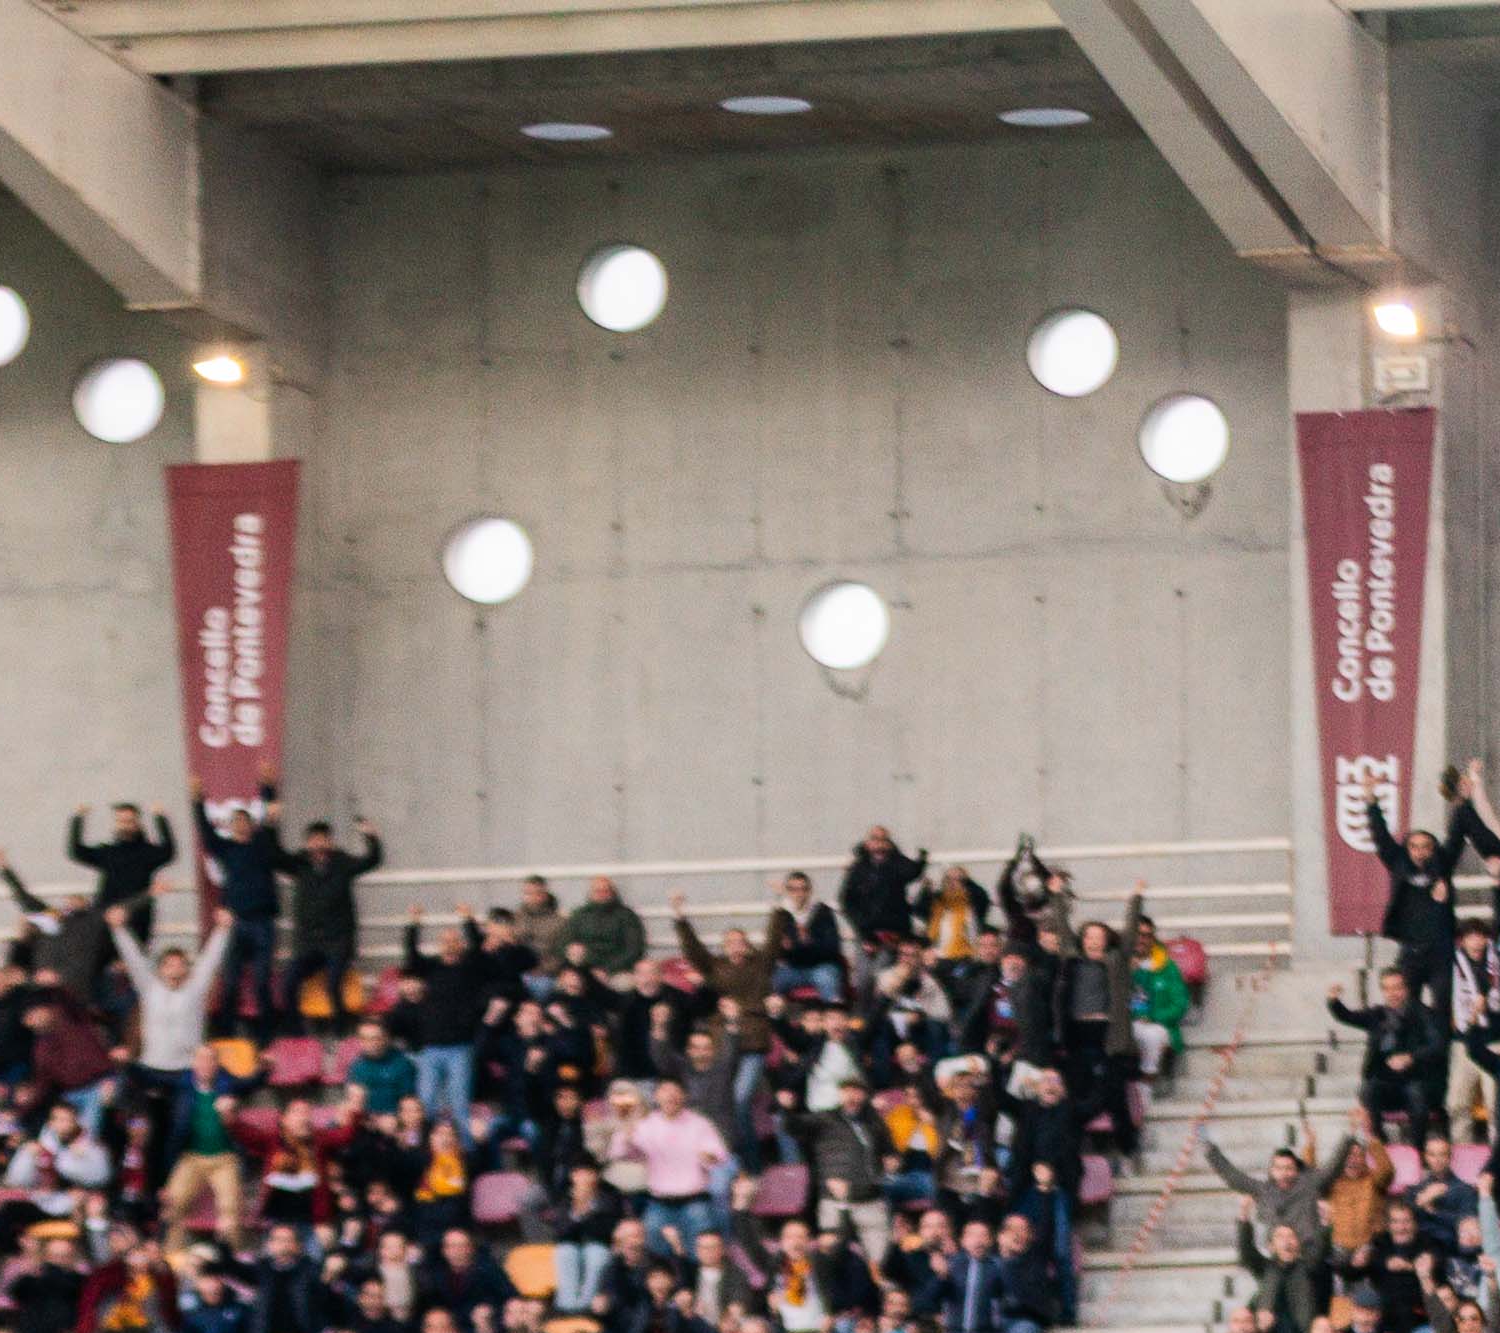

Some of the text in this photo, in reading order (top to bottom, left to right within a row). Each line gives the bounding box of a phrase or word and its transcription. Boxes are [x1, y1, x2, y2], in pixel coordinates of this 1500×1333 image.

[1332, 558, 1361, 702] Concello
[1365, 463, 1395, 701] de Pontevedra
